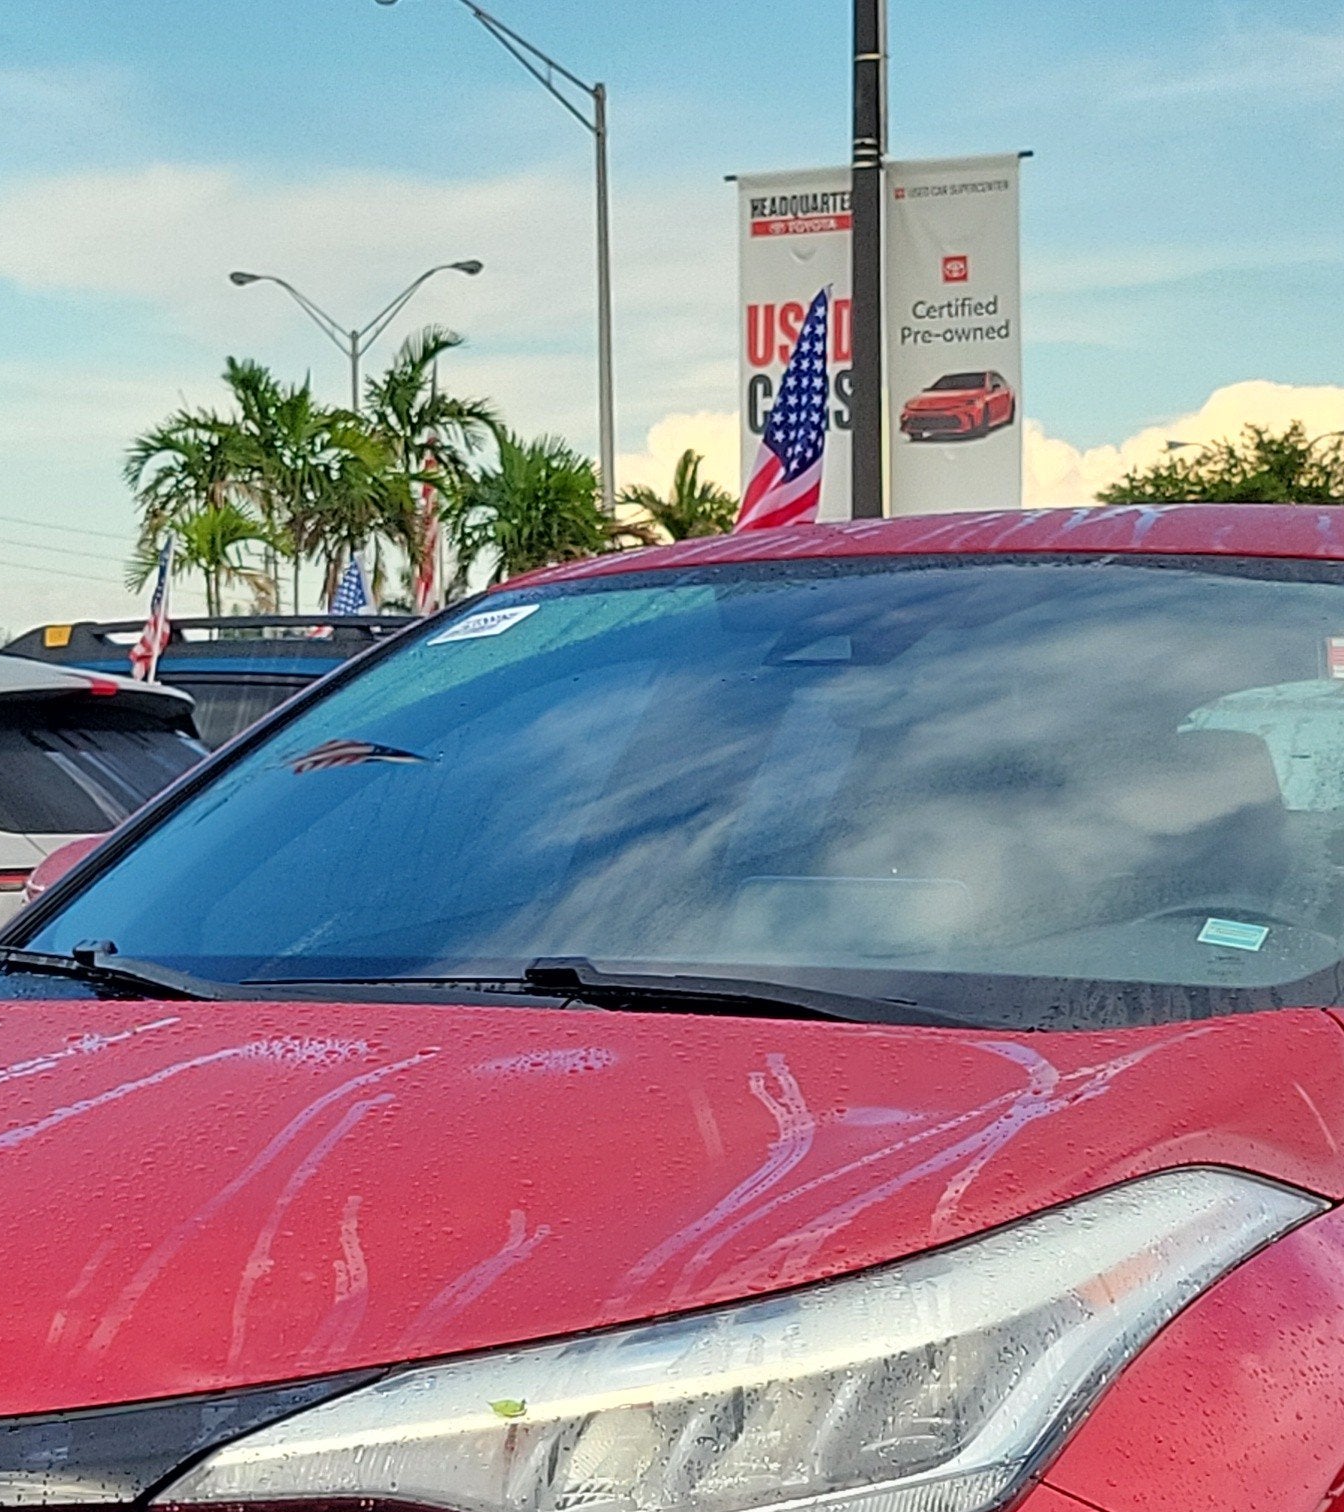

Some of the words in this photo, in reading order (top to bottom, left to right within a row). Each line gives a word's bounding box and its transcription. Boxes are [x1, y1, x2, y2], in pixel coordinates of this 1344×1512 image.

[750, 191, 853, 218] HEADQUARTE
[912, 295, 998, 321] Certified
[747, 299, 853, 367] USD
[900, 320, 1011, 346] Pre-owned
